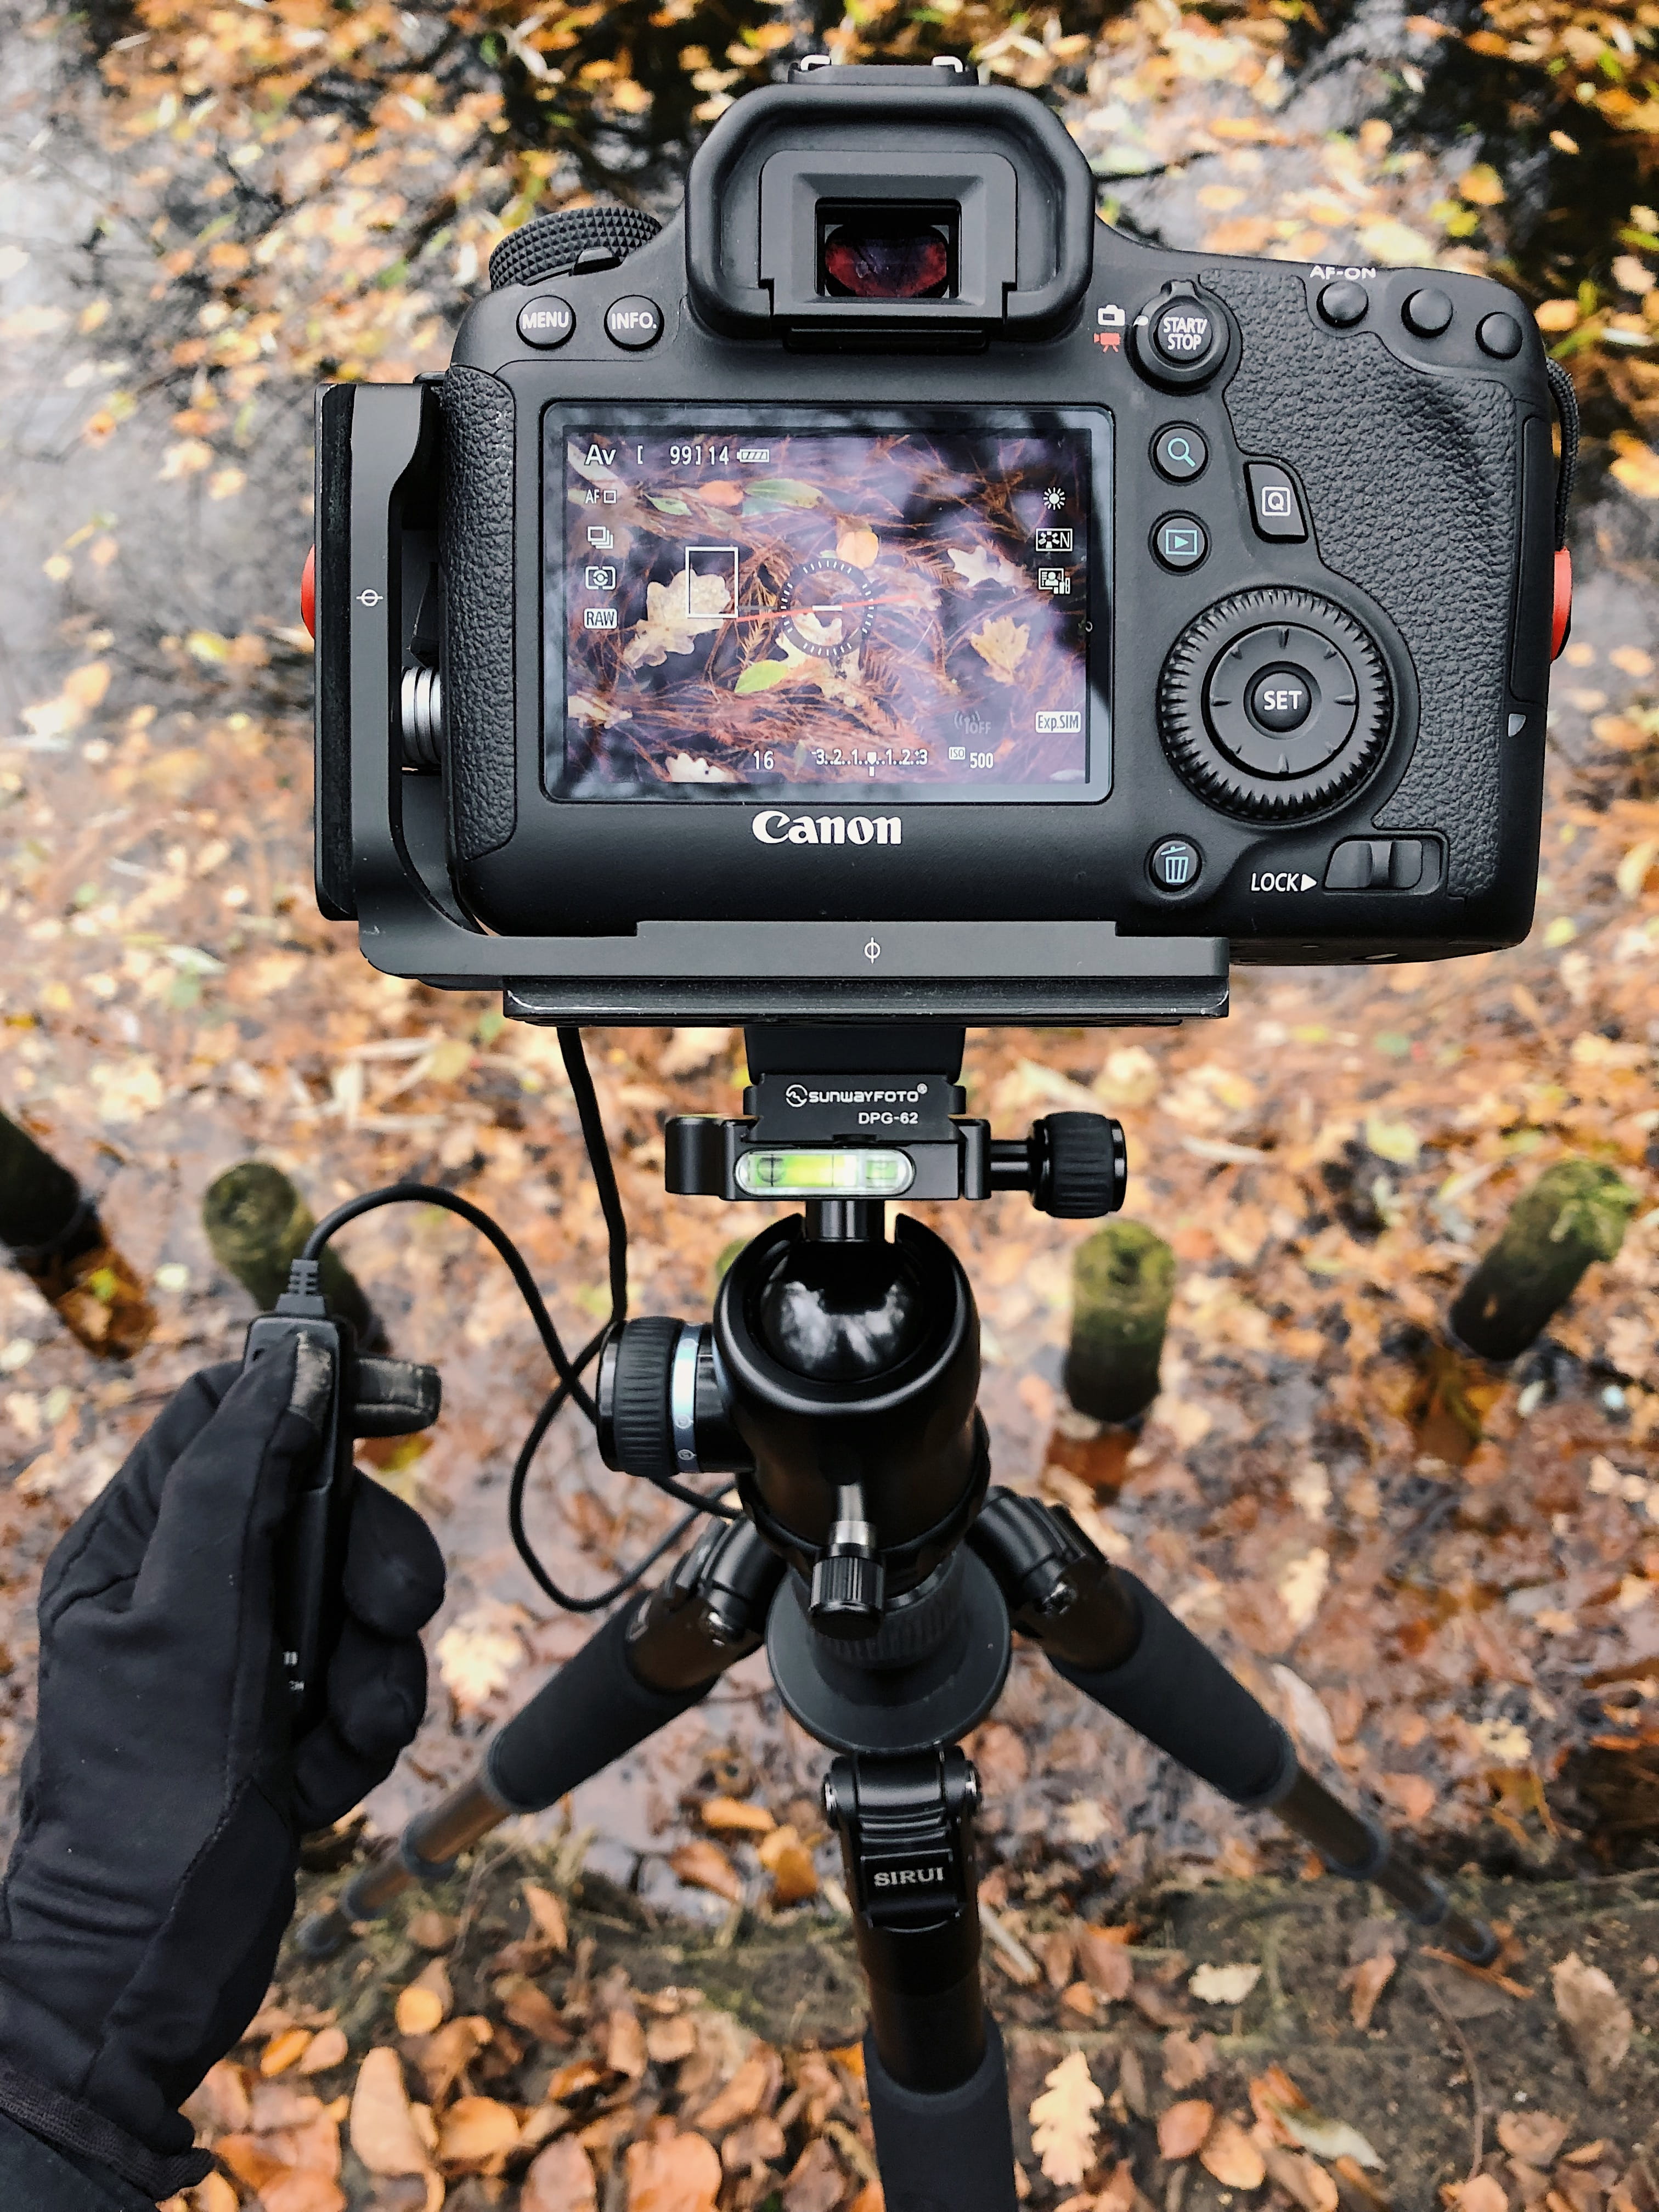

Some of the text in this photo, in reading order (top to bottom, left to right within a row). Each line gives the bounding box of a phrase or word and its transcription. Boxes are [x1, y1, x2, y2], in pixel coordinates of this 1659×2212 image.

[1310, 265, 1376, 280] AF-ON
[522, 311, 569, 329] MENU
[611, 312, 657, 330] INFO.
[1167, 333, 1201, 350] STOP
[584, 444, 616, 465] Av
[585, 489, 600, 504] AF
[586, 611, 614, 626] RAW
[1263, 690, 1302, 710] SET
[753, 750, 774, 770] 16
[950, 749, 994, 769] ISO 500
[752, 810, 901, 845] Canon
[1251, 873, 1298, 892] LOCK
[858, 1111, 918, 1125] DPG-62
[874, 1866, 944, 1887] SIRUI
